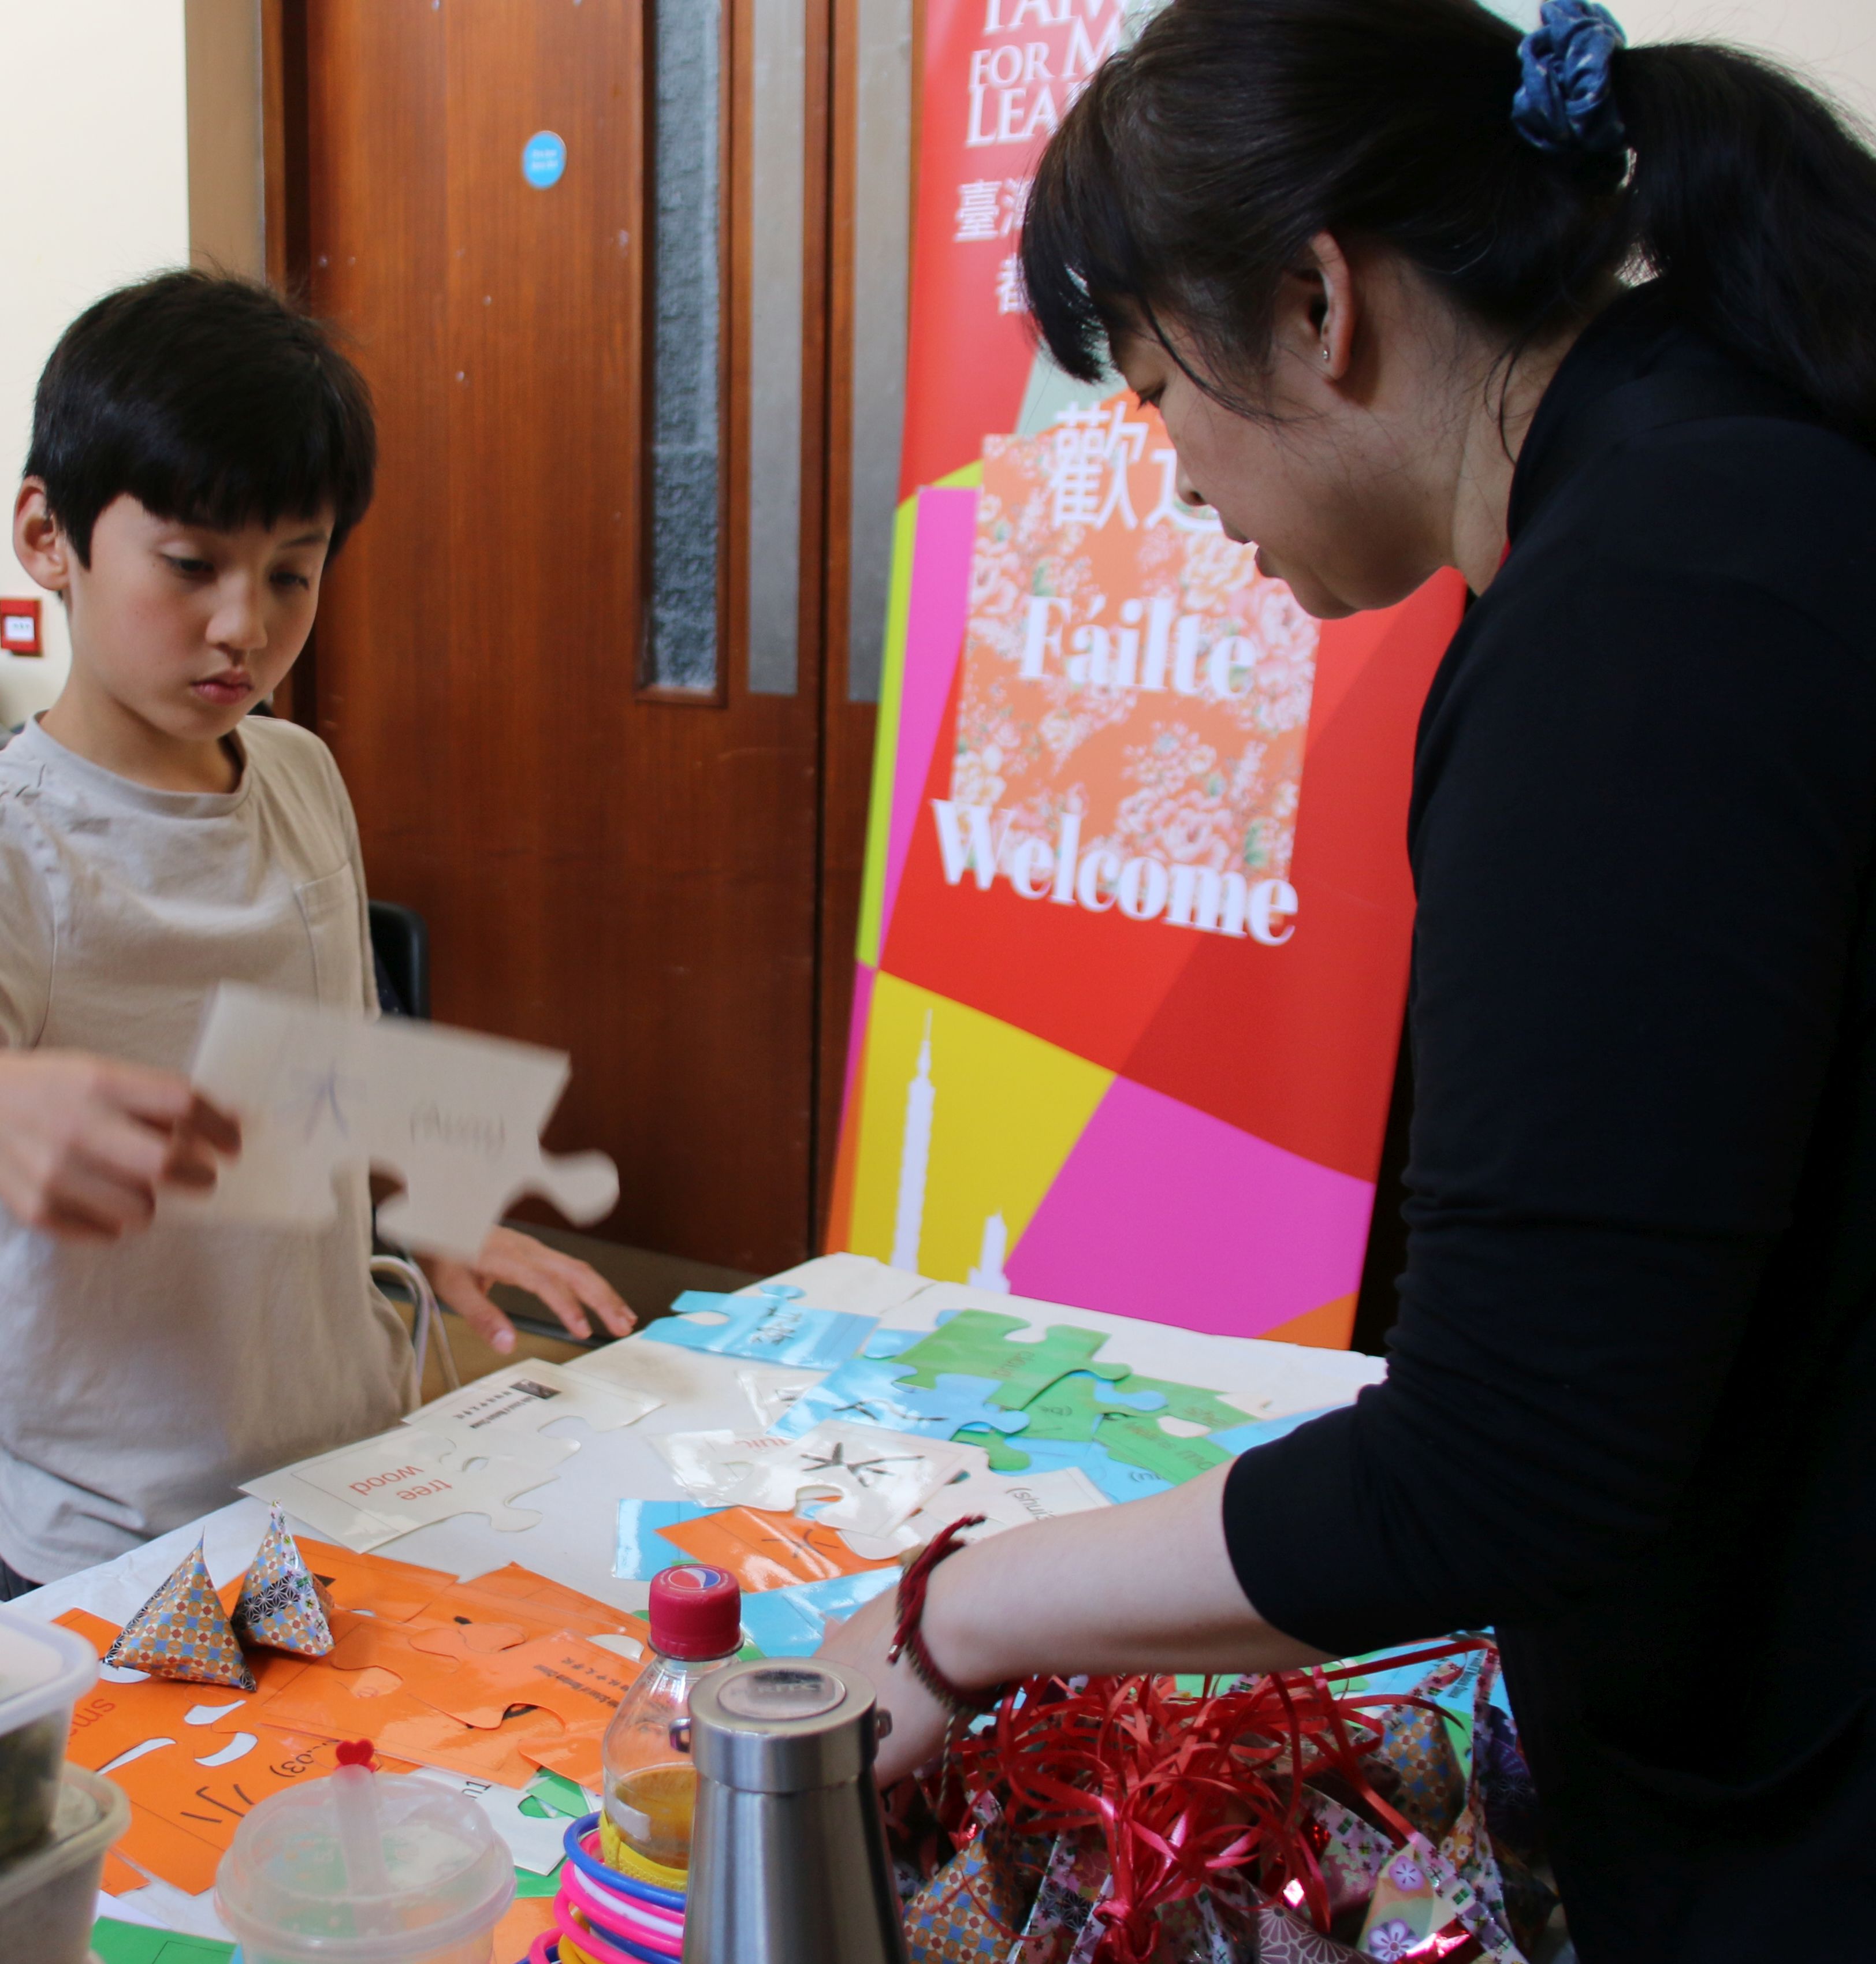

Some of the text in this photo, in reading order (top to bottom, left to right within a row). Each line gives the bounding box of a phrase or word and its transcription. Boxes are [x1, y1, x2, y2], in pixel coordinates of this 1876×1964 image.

[970, 42, 1055, 88] FOR
[1018, 595, 1257, 699] Fáilte
[929, 798, 1299, 947] Welcome
[348, 1464, 425, 1496] wood
[395, 1479, 453, 1501] tree
